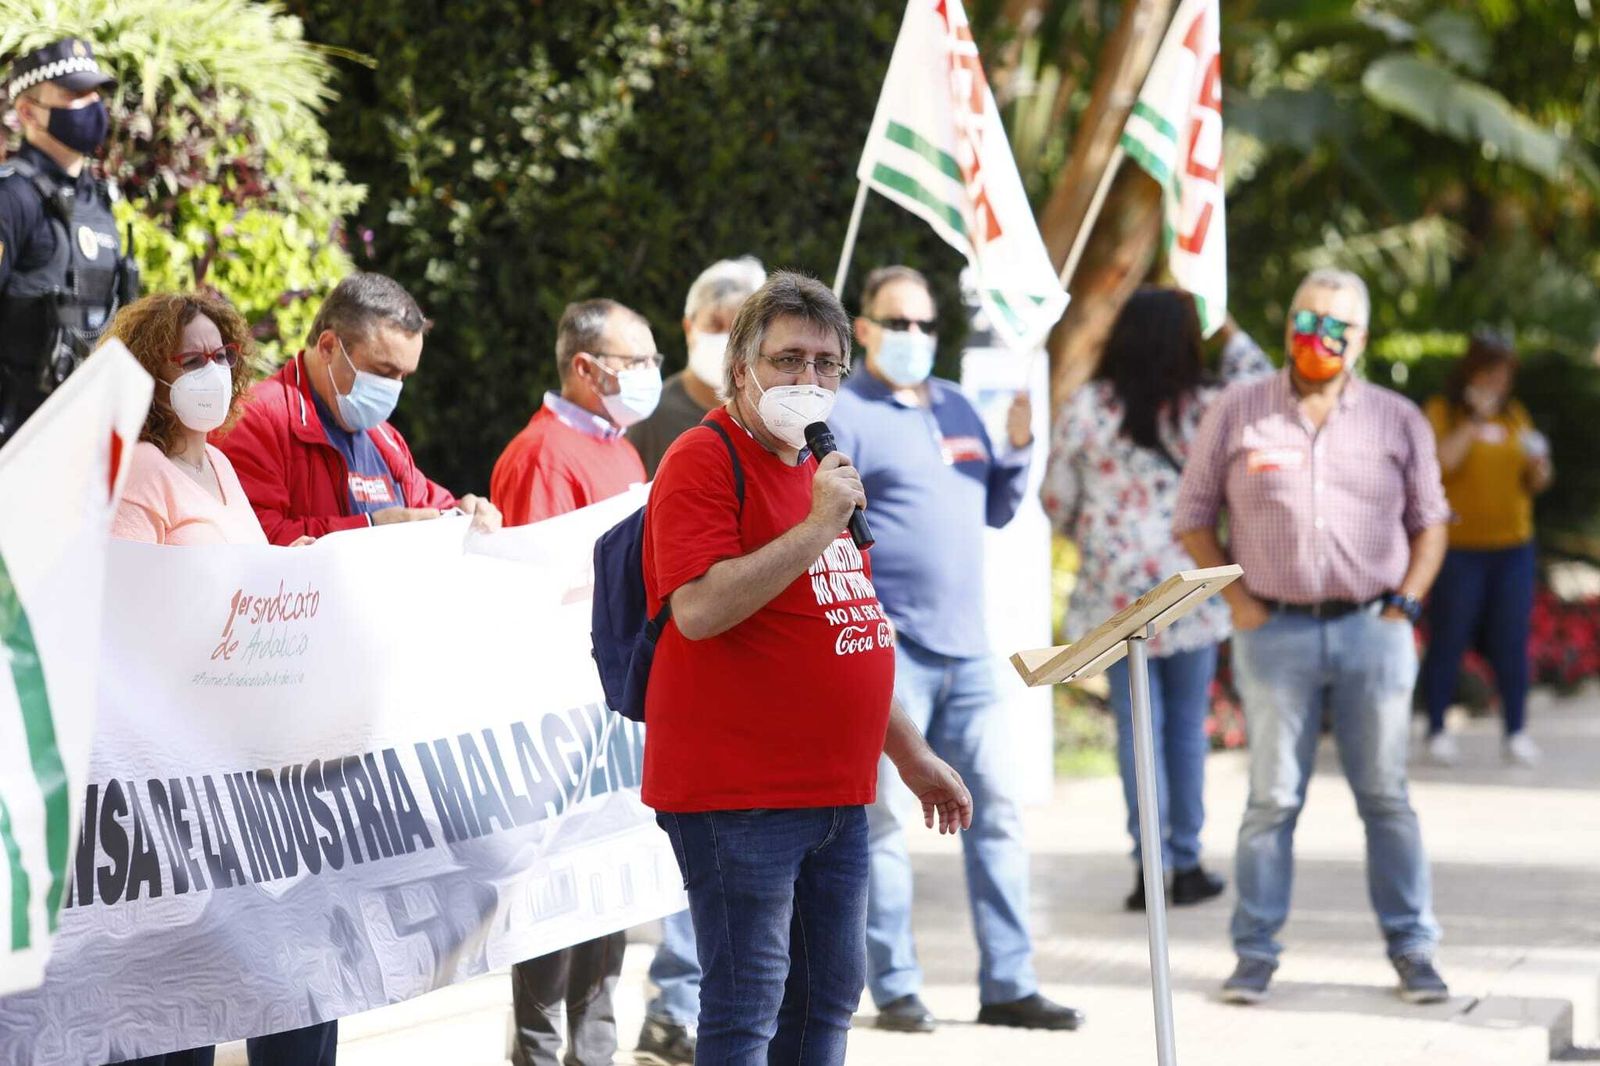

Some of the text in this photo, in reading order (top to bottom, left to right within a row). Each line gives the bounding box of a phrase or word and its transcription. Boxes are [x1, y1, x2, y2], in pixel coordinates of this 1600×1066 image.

[811, 573, 833, 606] NO
[825, 608, 848, 626] NO
[849, 606, 865, 622] AL
[211, 629, 239, 661] de
[835, 624, 874, 656] Coca
[147, 778, 207, 895] DE
[186, 775, 247, 890] LA
[224, 748, 434, 883] INDUSTRIA
